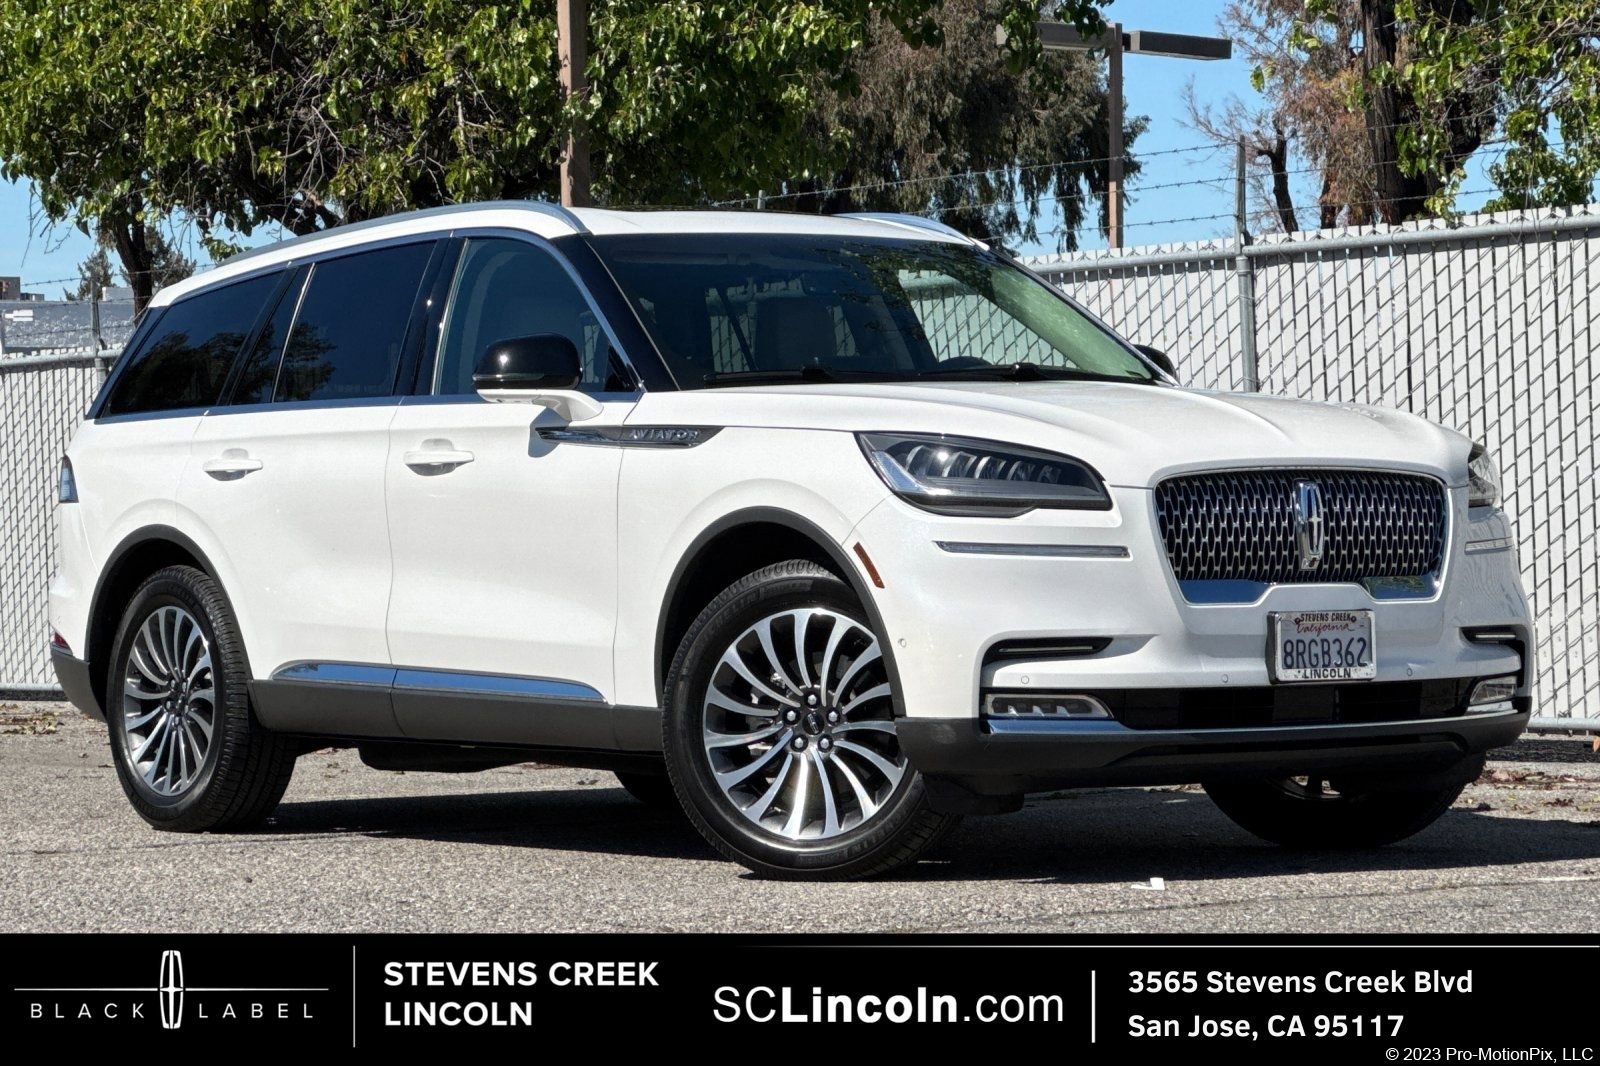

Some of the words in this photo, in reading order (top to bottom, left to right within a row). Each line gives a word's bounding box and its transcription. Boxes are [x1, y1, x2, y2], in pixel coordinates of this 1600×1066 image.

[629, 428, 700, 441] AVIATOR
[1300, 613, 1329, 622] STEVENS
[1331, 613, 1351, 622] CREEK
[1296, 622, 1355, 637] California
[1283, 637, 1368, 669] 8RGB362
[1304, 669, 1351, 679] LINCOLN
